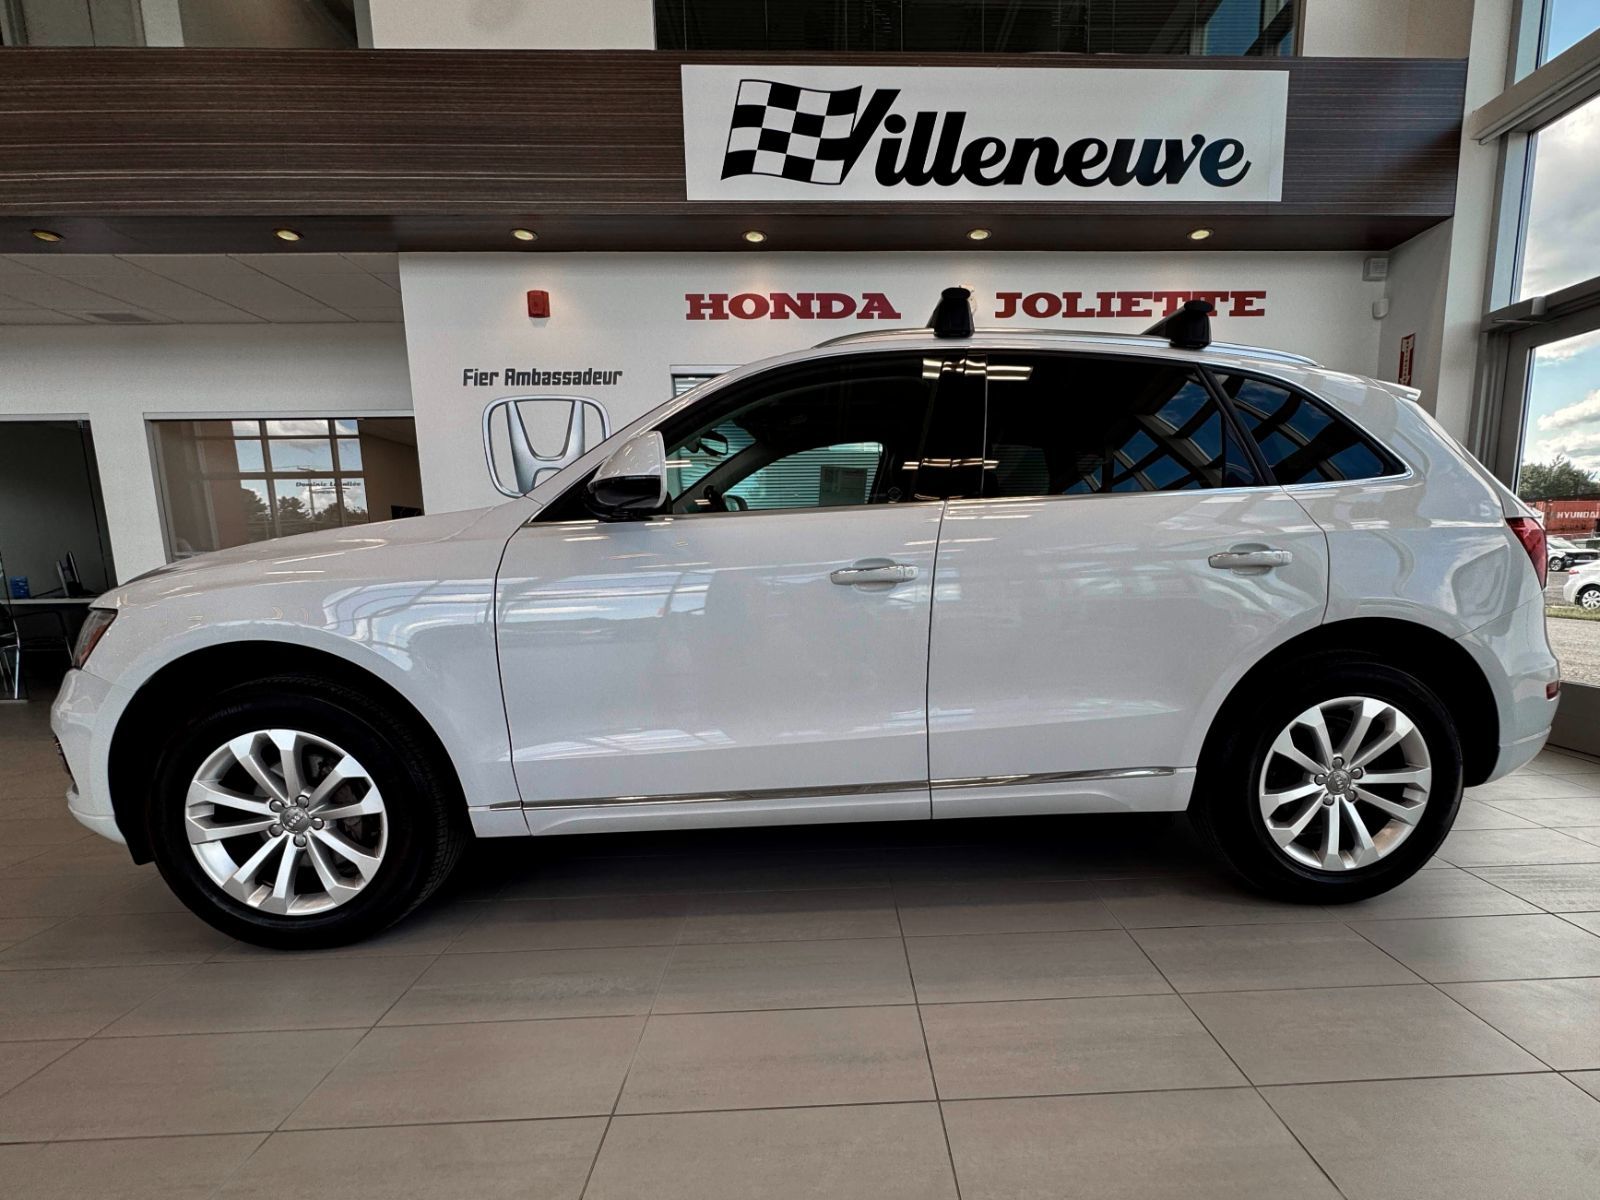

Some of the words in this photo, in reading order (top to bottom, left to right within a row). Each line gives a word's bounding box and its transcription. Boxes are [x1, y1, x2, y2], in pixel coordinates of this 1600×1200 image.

[840, 88, 1252, 187] Villeneuve
[685, 292, 902, 320] HONDA
[994, 290, 1267, 319] JOLIETTE
[463, 368, 499, 387] Fier
[504, 367, 623, 386] Ambassadeur
[1556, 511, 1600, 519] HYUNDAI
